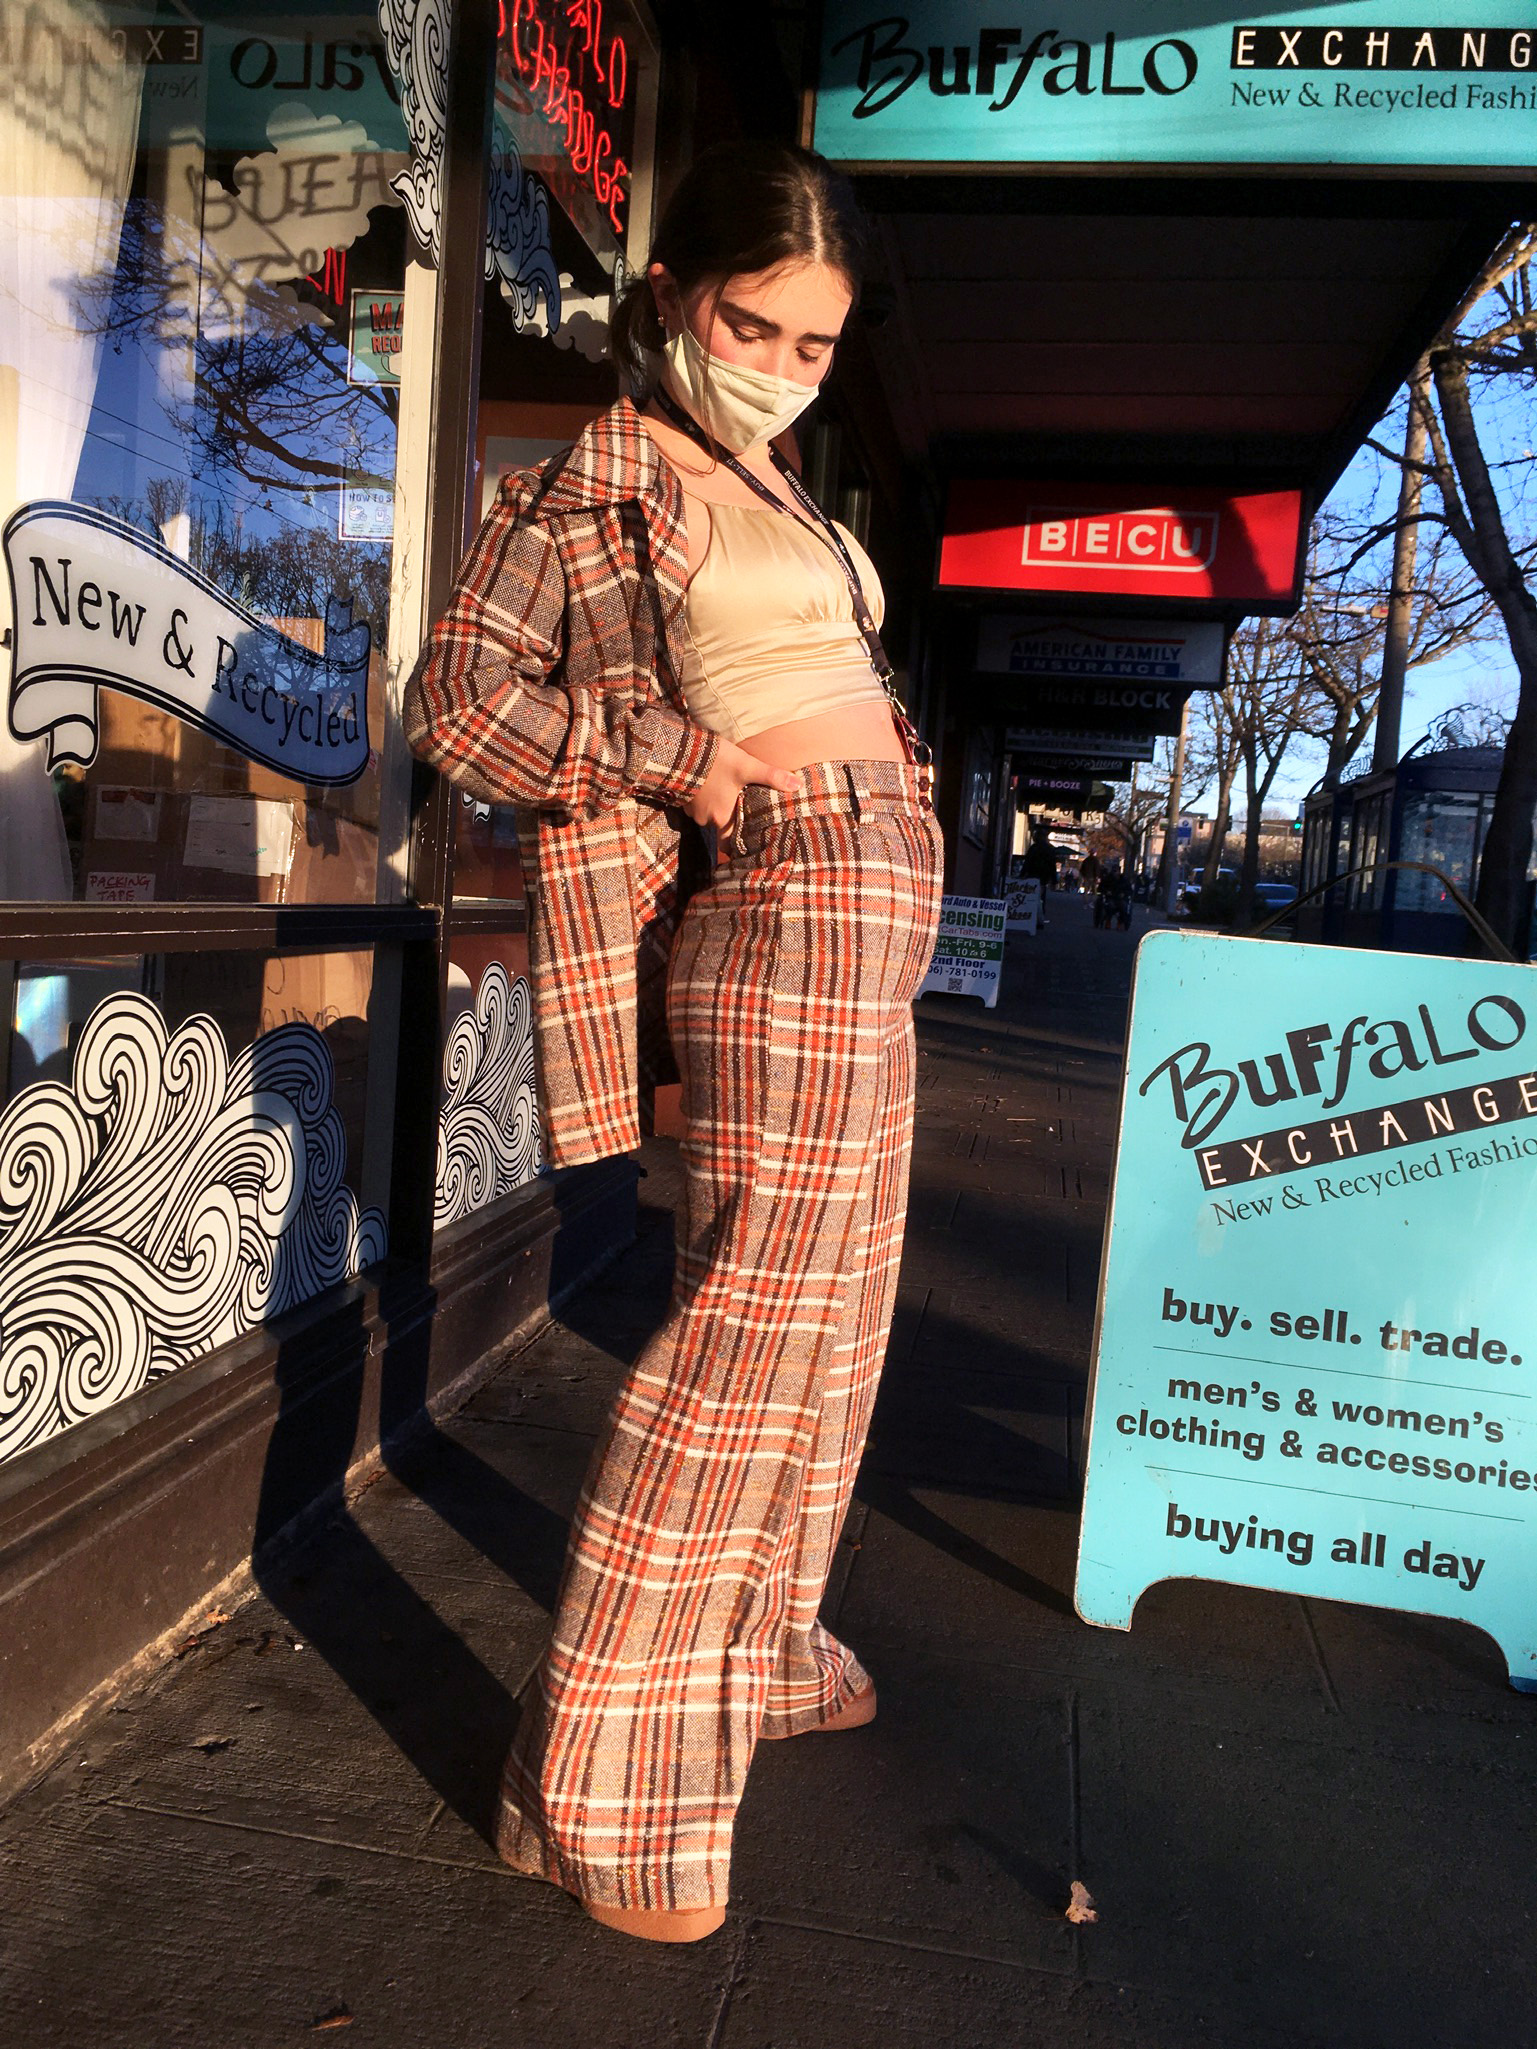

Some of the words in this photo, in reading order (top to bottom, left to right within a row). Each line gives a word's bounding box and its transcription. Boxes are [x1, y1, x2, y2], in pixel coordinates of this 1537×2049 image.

[1238, 29, 1537, 70] EXCHANG
[1231, 83, 1291, 108] New
[1299, 83, 1323, 108] &
[1334, 82, 1456, 110] Recycled
[1466, 84, 1537, 110] Fashi
[784, 470, 807, 498] BUFFALO
[803, 494, 830, 526] EXCHANGE
[1038, 521, 1203, 558] BECU
[29, 555, 147, 647] New
[162, 608, 196, 678] &
[211, 635, 361, 747] Recycled
[1011, 640, 1106, 660] AMERICAN
[1114, 645, 1182, 661] FAMILY
[1022, 660, 1167, 675] INSURANCE
[1092, 688, 1171, 710] BLOCK
[1028, 778, 1042, 788] PIE
[1049, 779, 1081, 790] BOOZE
[89, 874, 151, 890] PACKING
[96, 889, 136, 901] TAPE
[953, 897, 971, 908] Auto
[972, 900, 979, 909] &
[980, 900, 1006, 912] Vessel
[940, 909, 1004, 932] censing
[956, 948, 968, 956] 10
[980, 949, 987, 958] 6
[978, 940, 998, 950] 9-6
[931, 956, 952, 966] 2nd
[955, 957, 985, 969] Floor
[1202, 1076, 1537, 1187] EXCHANGE
[1212, 1194, 1274, 1227] New
[1281, 1184, 1313, 1213] &
[1316, 1159, 1443, 1204] Recycled
[1446, 1135, 1537, 1176] Fashio
[1162, 1287, 1252, 1338] buy.
[1269, 1308, 1362, 1345] sell.
[1379, 1320, 1523, 1367] trade.
[1167, 1377, 1281, 1413] men’s
[1294, 1388, 1318, 1416] &
[1332, 1399, 1504, 1443] women’s
[1115, 1409, 1265, 1461] clothing
[1279, 1429, 1302, 1458] &
[1316, 1441, 1537, 1492] accessorie
[1166, 1502, 1314, 1566] buying
[1330, 1532, 1386, 1567] all
[1403, 1540, 1486, 1592] day
